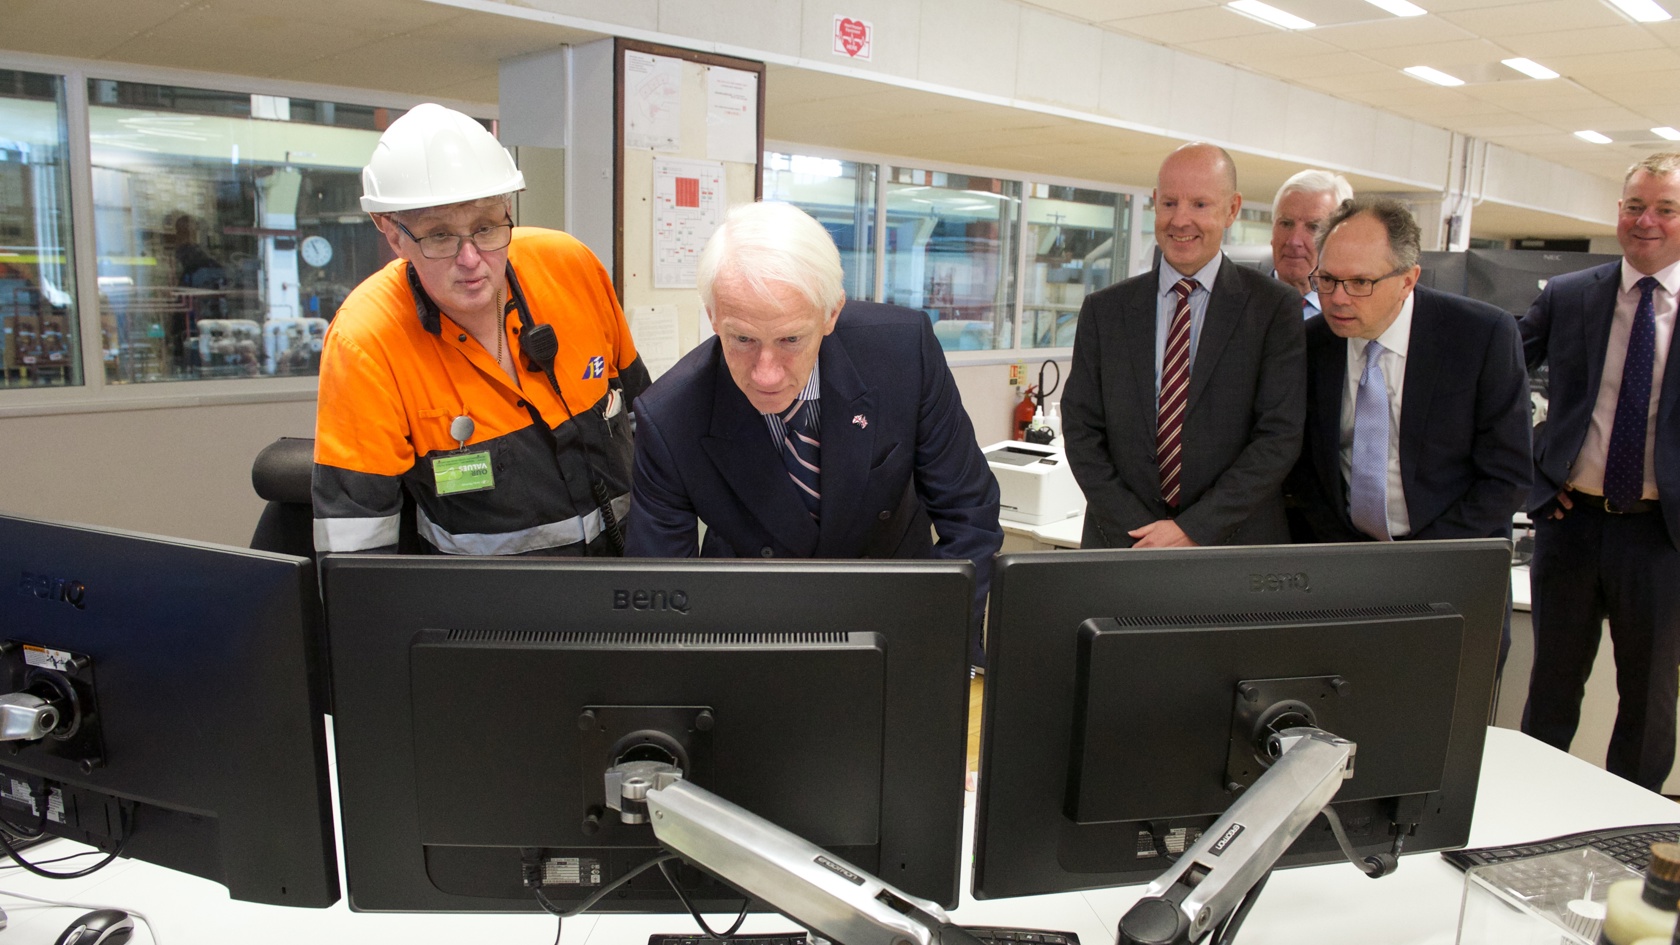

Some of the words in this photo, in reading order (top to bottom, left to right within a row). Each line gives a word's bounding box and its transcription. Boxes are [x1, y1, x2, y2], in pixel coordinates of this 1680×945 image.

[458, 463, 488, 472] VALUES
[471, 469, 488, 477] OUR
[1249, 572, 1312, 594] BenQ
[612, 588, 691, 615] BenQ
